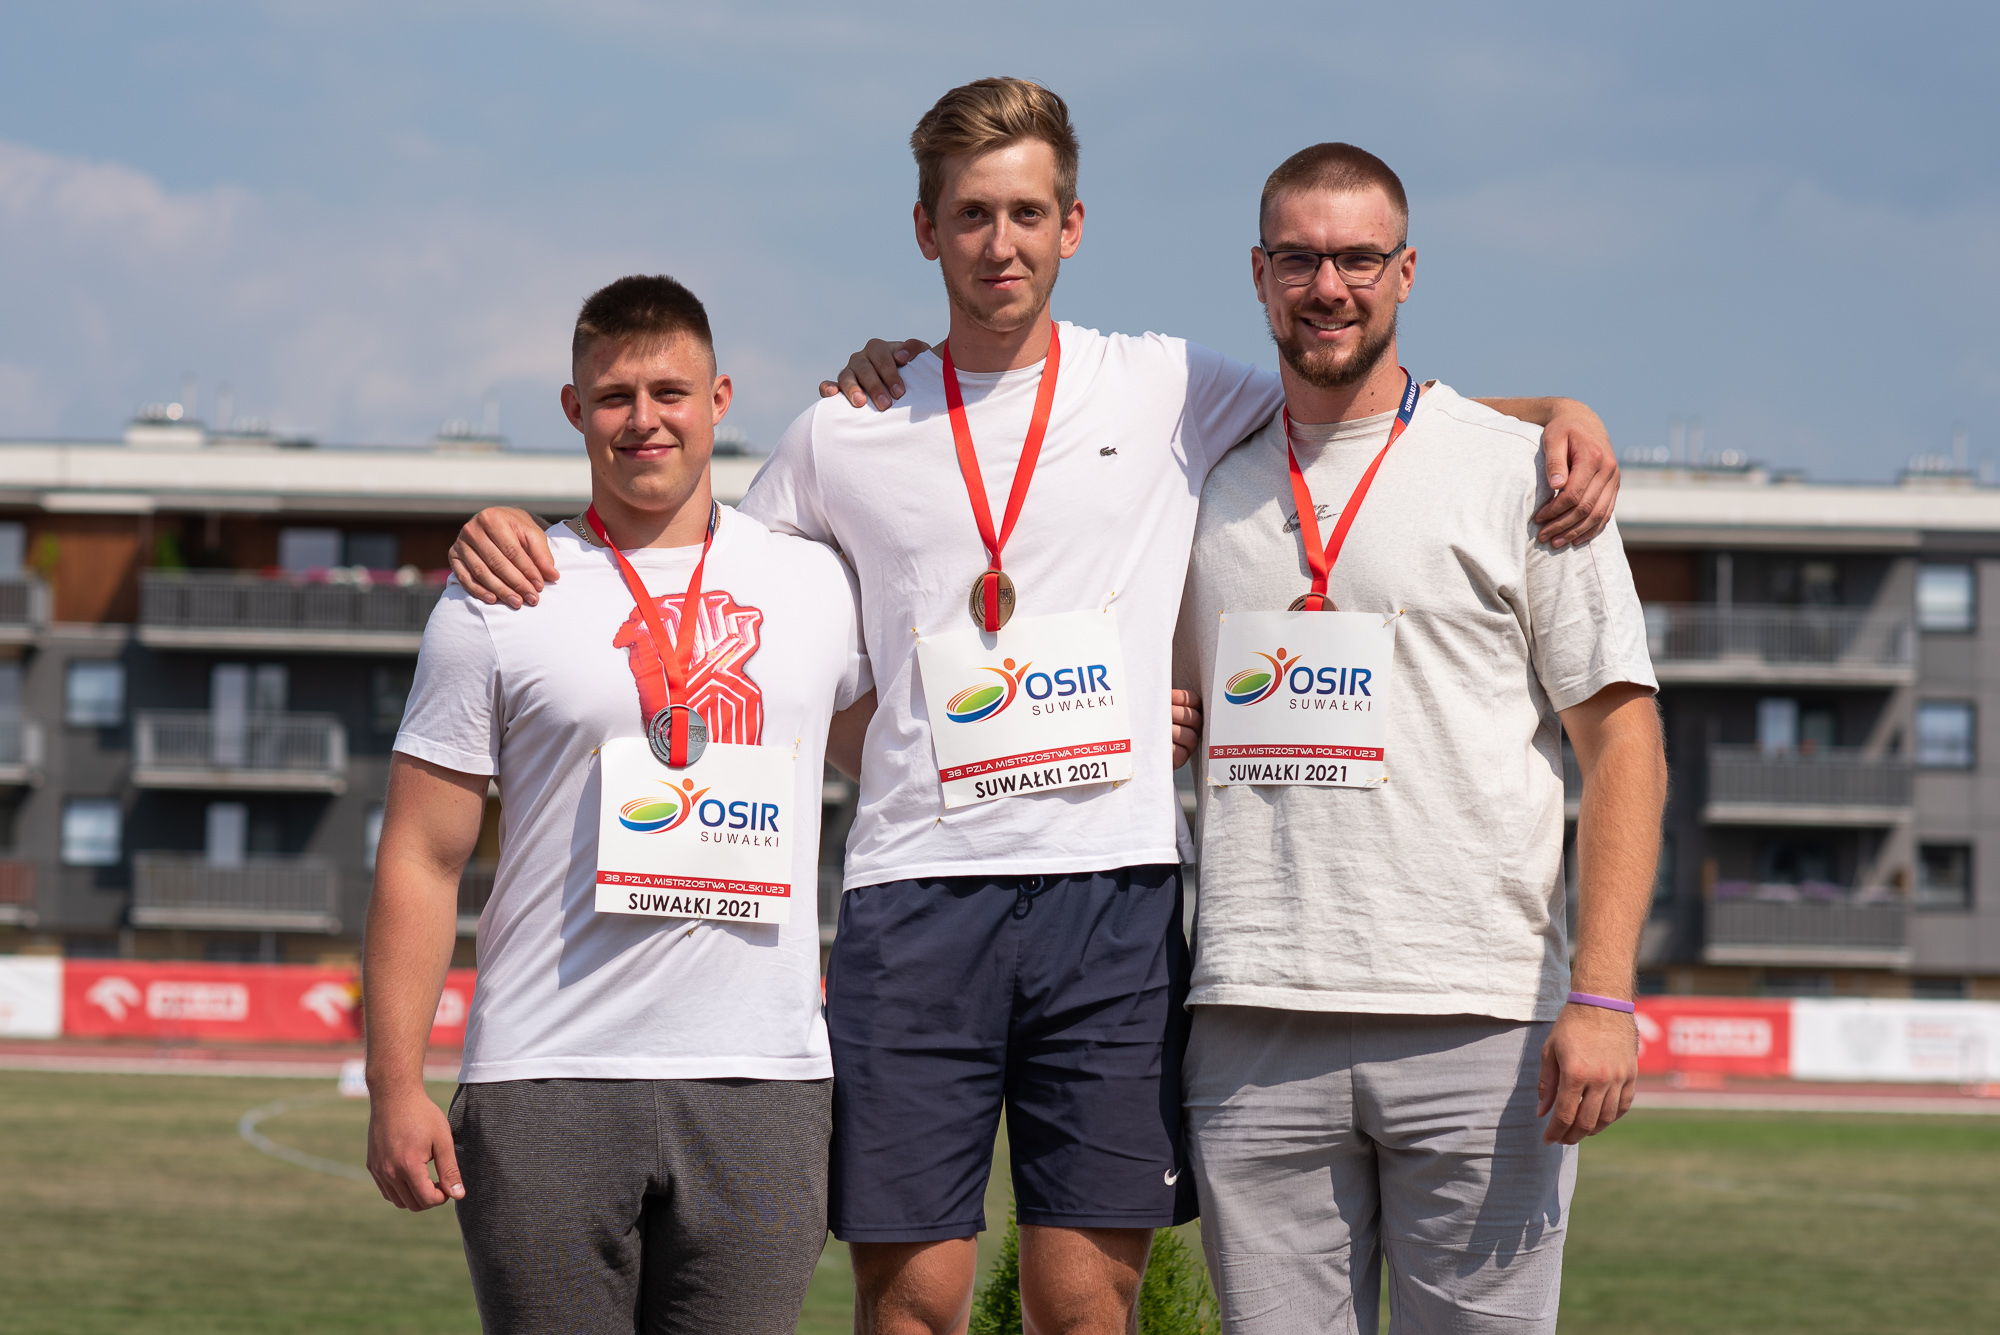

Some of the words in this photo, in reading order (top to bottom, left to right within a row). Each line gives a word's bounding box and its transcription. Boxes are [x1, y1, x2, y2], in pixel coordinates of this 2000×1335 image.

[1025, 664, 1112, 700] OSIR
[1289, 666, 1372, 697] OSIR
[1032, 695, 1114, 716] SUWAŁKI
[1289, 698, 1371, 712] SUWAŁKI
[947, 769, 965, 779] 38.
[966, 764, 994, 776] PZLA
[995, 749, 1073, 770] MISTRZOSTWA
[1073, 745, 1108, 757] POLSKI
[1109, 742, 1127, 752] U23
[1226, 748, 1248, 756] PZLA
[1248, 747, 1314, 756] MISTRZOSTWA
[1315, 748, 1351, 757] POLSKI
[1354, 750, 1377, 758] U23
[975, 767, 1063, 799] SUWAŁKI
[1067, 761, 1109, 783] 2021
[1228, 764, 1300, 782] SUWAŁKI
[1304, 764, 1348, 783] 2021
[698, 798, 779, 833] OSIR
[700, 831, 780, 848] SUWAŁKI
[604, 874, 622, 883] 38.
[624, 876, 652, 886] PZLA
[653, 878, 727, 890] MISTRZOSTWA
[728, 883, 763, 893] POLSKI
[765, 885, 785, 894] U23
[628, 892, 711, 915] SUWAŁKI
[716, 899, 760, 919] 2021
